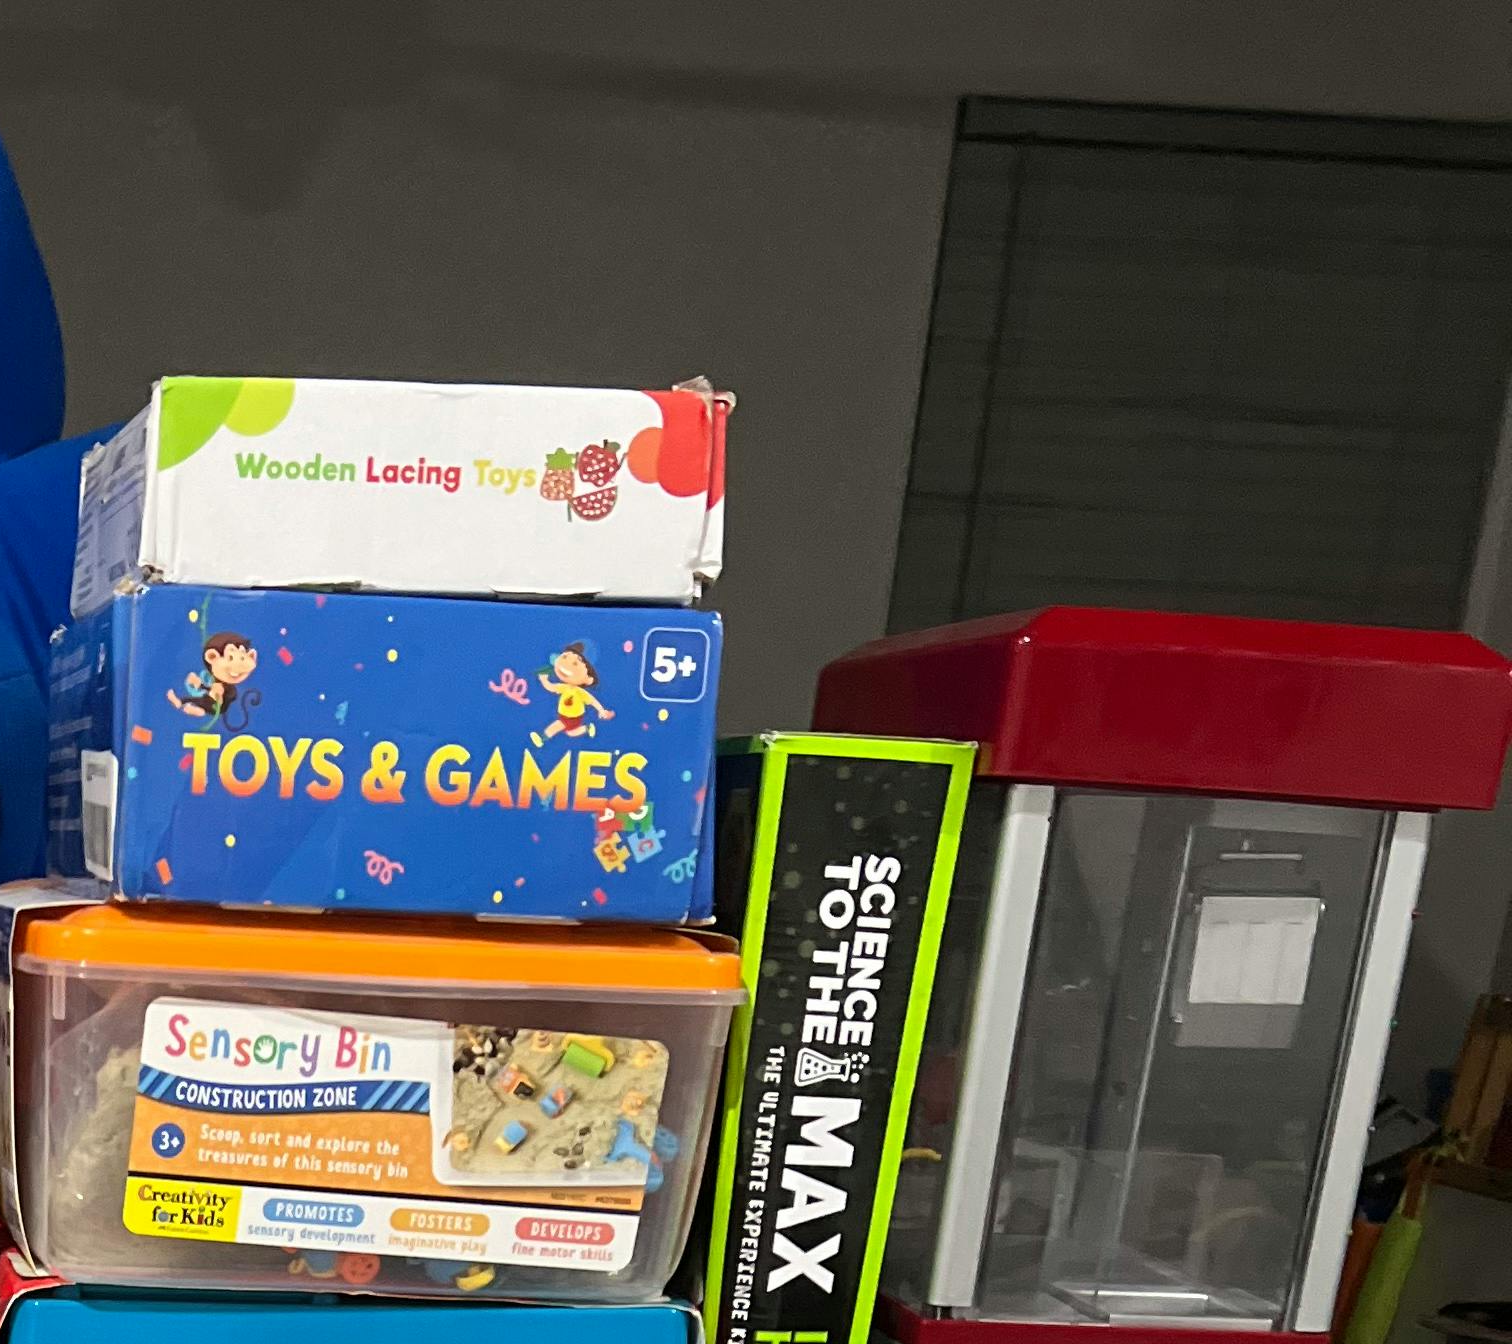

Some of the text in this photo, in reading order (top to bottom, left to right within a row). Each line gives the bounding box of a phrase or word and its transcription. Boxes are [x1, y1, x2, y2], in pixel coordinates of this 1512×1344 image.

[236, 453, 536, 494] Wooden Lacing Toys
[649, 647, 696, 683] 5+
[182, 733, 648, 813] TOYS & GAMES
[801, 855, 863, 1045] TO THE
[838, 854, 901, 1047] SCIENCE
[165, 1013, 392, 1077] Sensory Bin
[763, 1045, 785, 1084] THE
[175, 1081, 358, 1110] CONSTRUCTION ZONE
[158, 1130, 180, 1151] 3+
[200, 1123, 400, 1157] Scoop, sort and explore the
[748, 1090, 779, 1192] ULTIMATE
[198, 1147, 408, 1181] treasures of this sensory bin
[138, 1184, 231, 1210] Creativity
[766, 1095, 863, 1294] MAX
[152, 1206, 225, 1228] for Kids
[275, 1201, 355, 1223] PROMOTES
[409, 1212, 474, 1232] FOSTERS
[248, 1224, 376, 1246] sensory development
[389, 1235, 487, 1257] imaginative play
[529, 1222, 603, 1242] DEVELOPS
[512, 1243, 613, 1262] fine motor skills
[731, 1199, 765, 1321] EXPERIENCE
